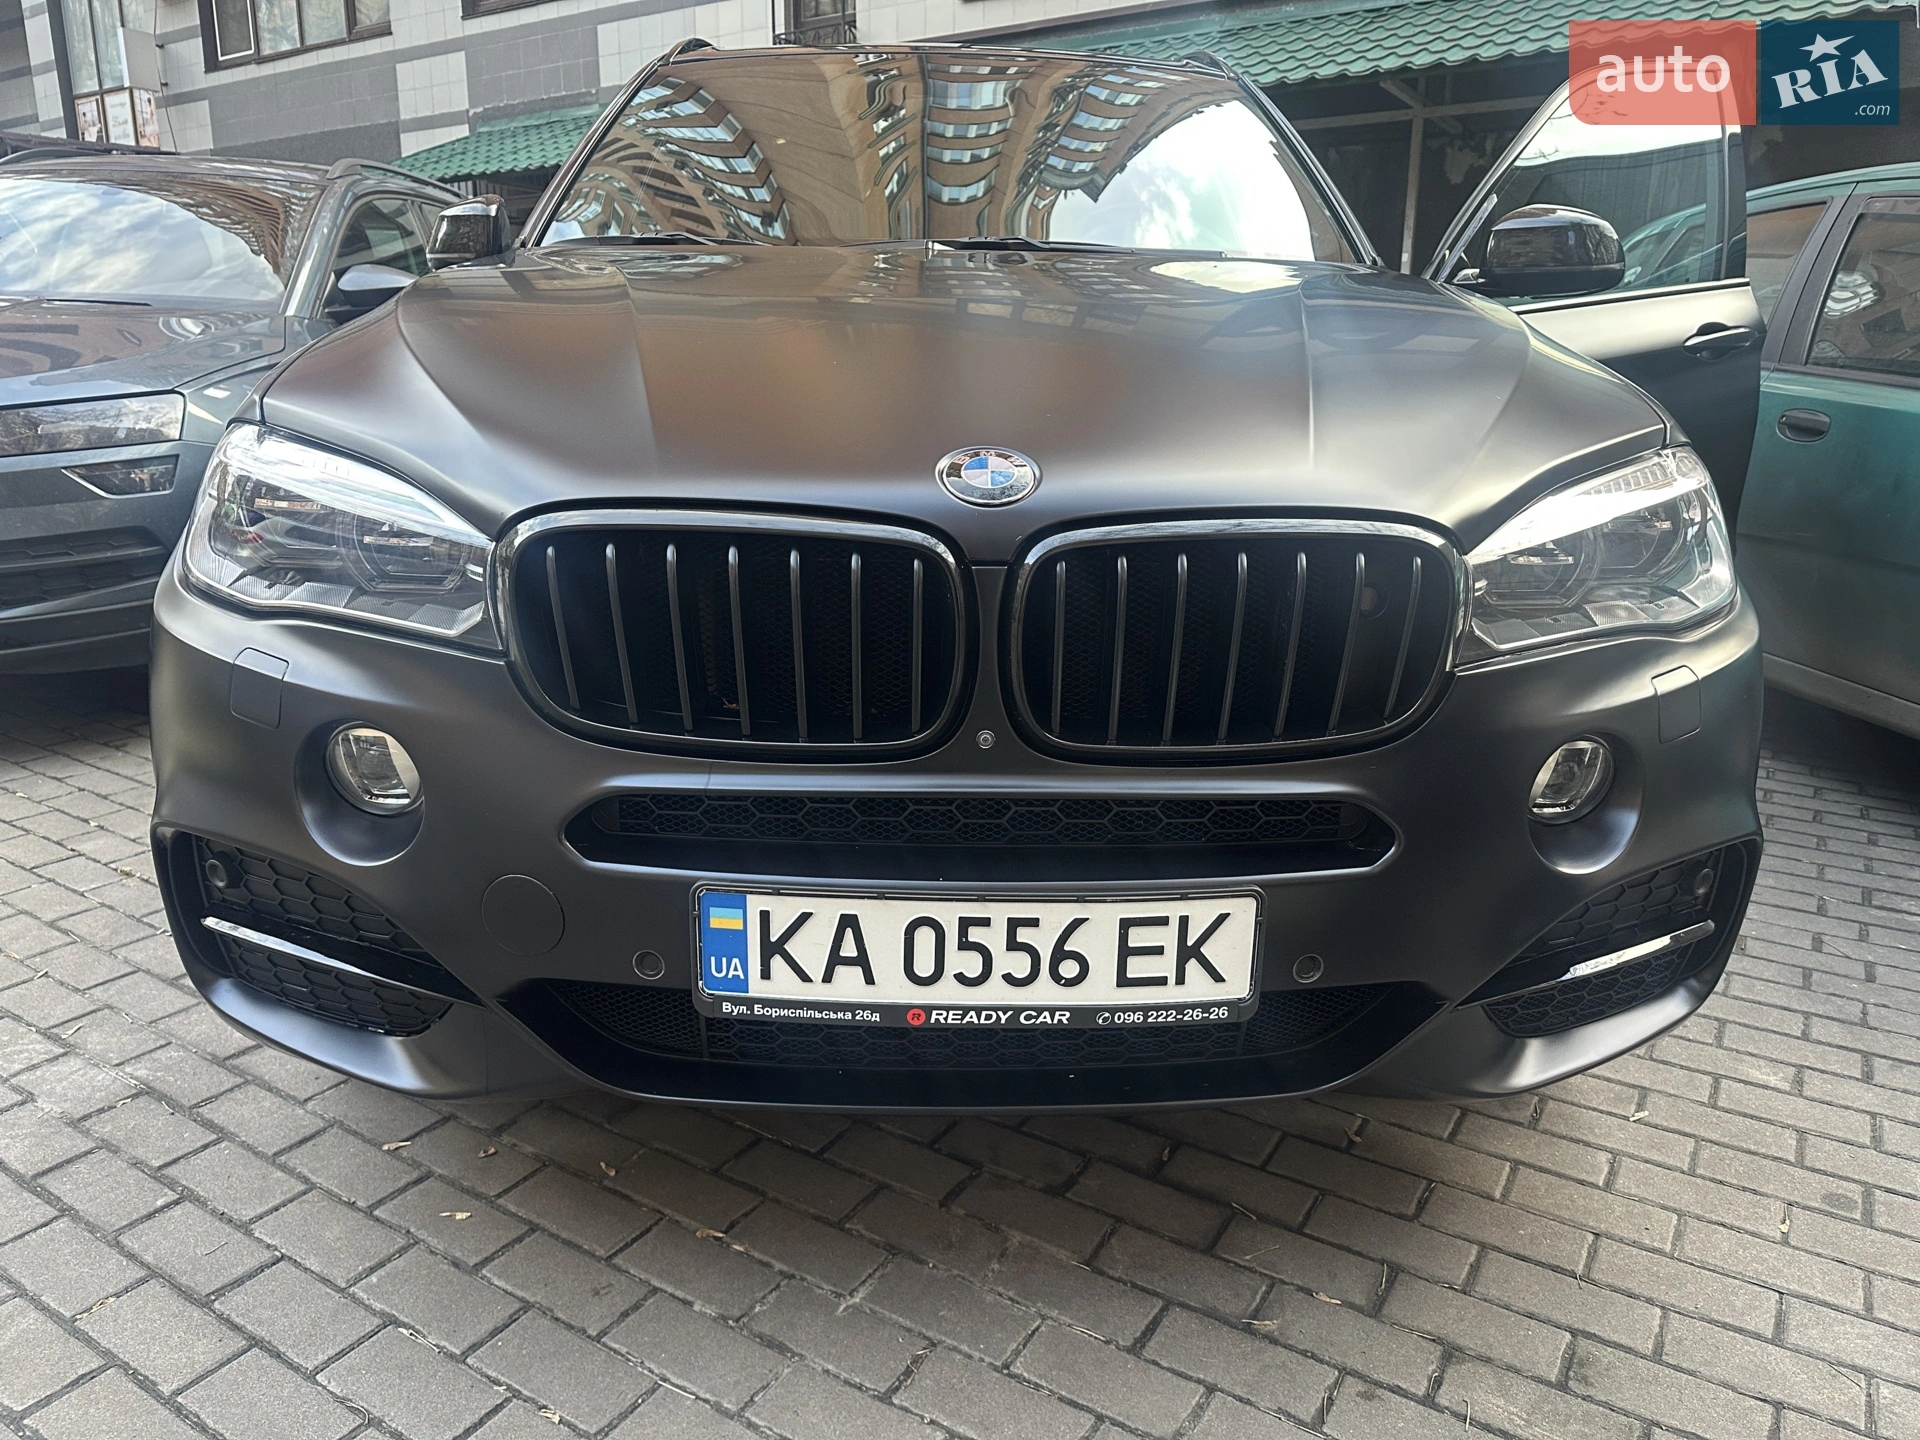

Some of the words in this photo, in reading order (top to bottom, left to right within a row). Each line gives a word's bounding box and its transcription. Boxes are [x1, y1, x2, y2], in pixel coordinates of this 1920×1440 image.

[759, 909, 876, 985] KA
[903, 914, 1091, 988] 0556
[1116, 912, 1231, 988] EK
[710, 956, 745, 980] UA
[722, 1002, 751, 1017] Вул.
[753, 1004, 852, 1020] Бориспільська
[855, 1009, 880, 1022] 26д
[930, 1010, 1013, 1024] READY
[1019, 1010, 1071, 1025] CAR
[1114, 1011, 1143, 1024] 096
[1147, 1006, 1229, 1023] 222-26-26
